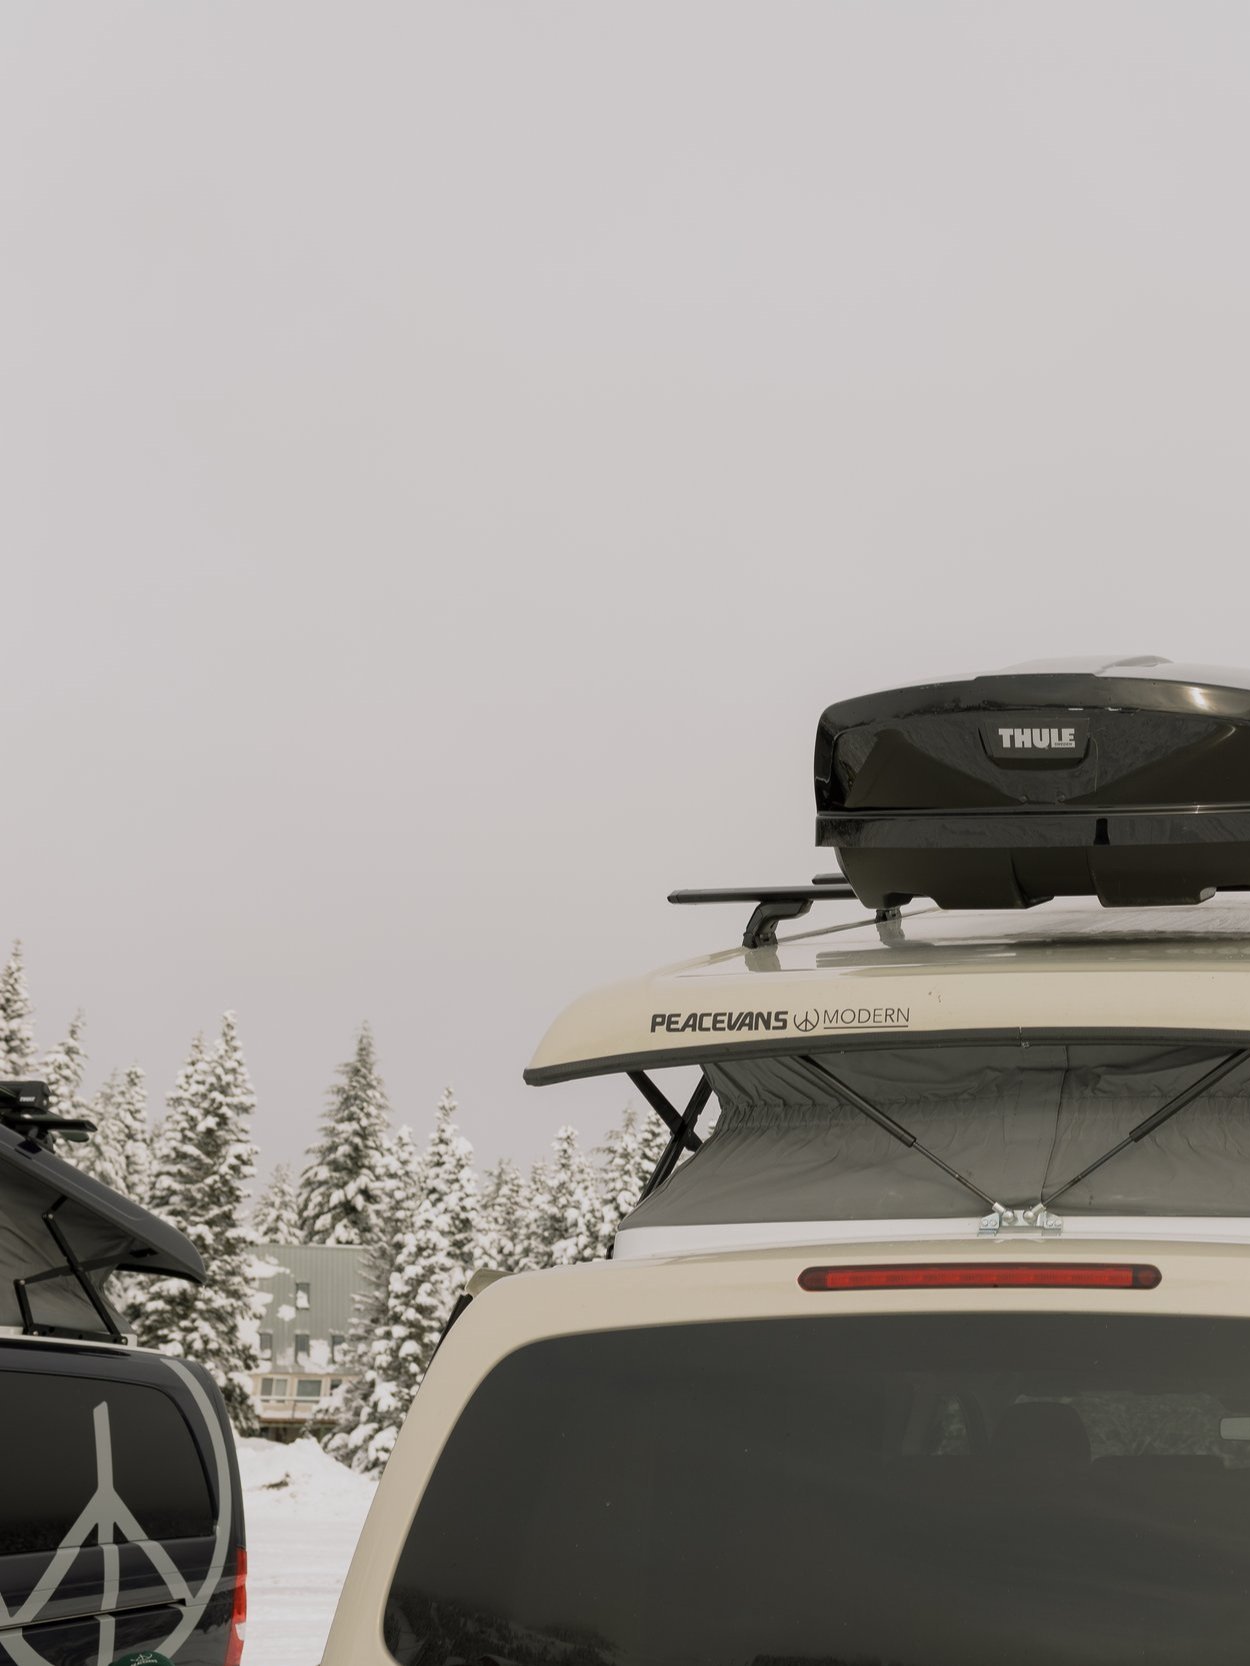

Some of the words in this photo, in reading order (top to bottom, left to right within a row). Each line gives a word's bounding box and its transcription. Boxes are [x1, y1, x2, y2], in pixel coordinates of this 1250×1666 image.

[998, 728, 1076, 748] THULE
[650, 1010, 788, 1033] PEACEVANS
[823, 1008, 910, 1025] MODERN
